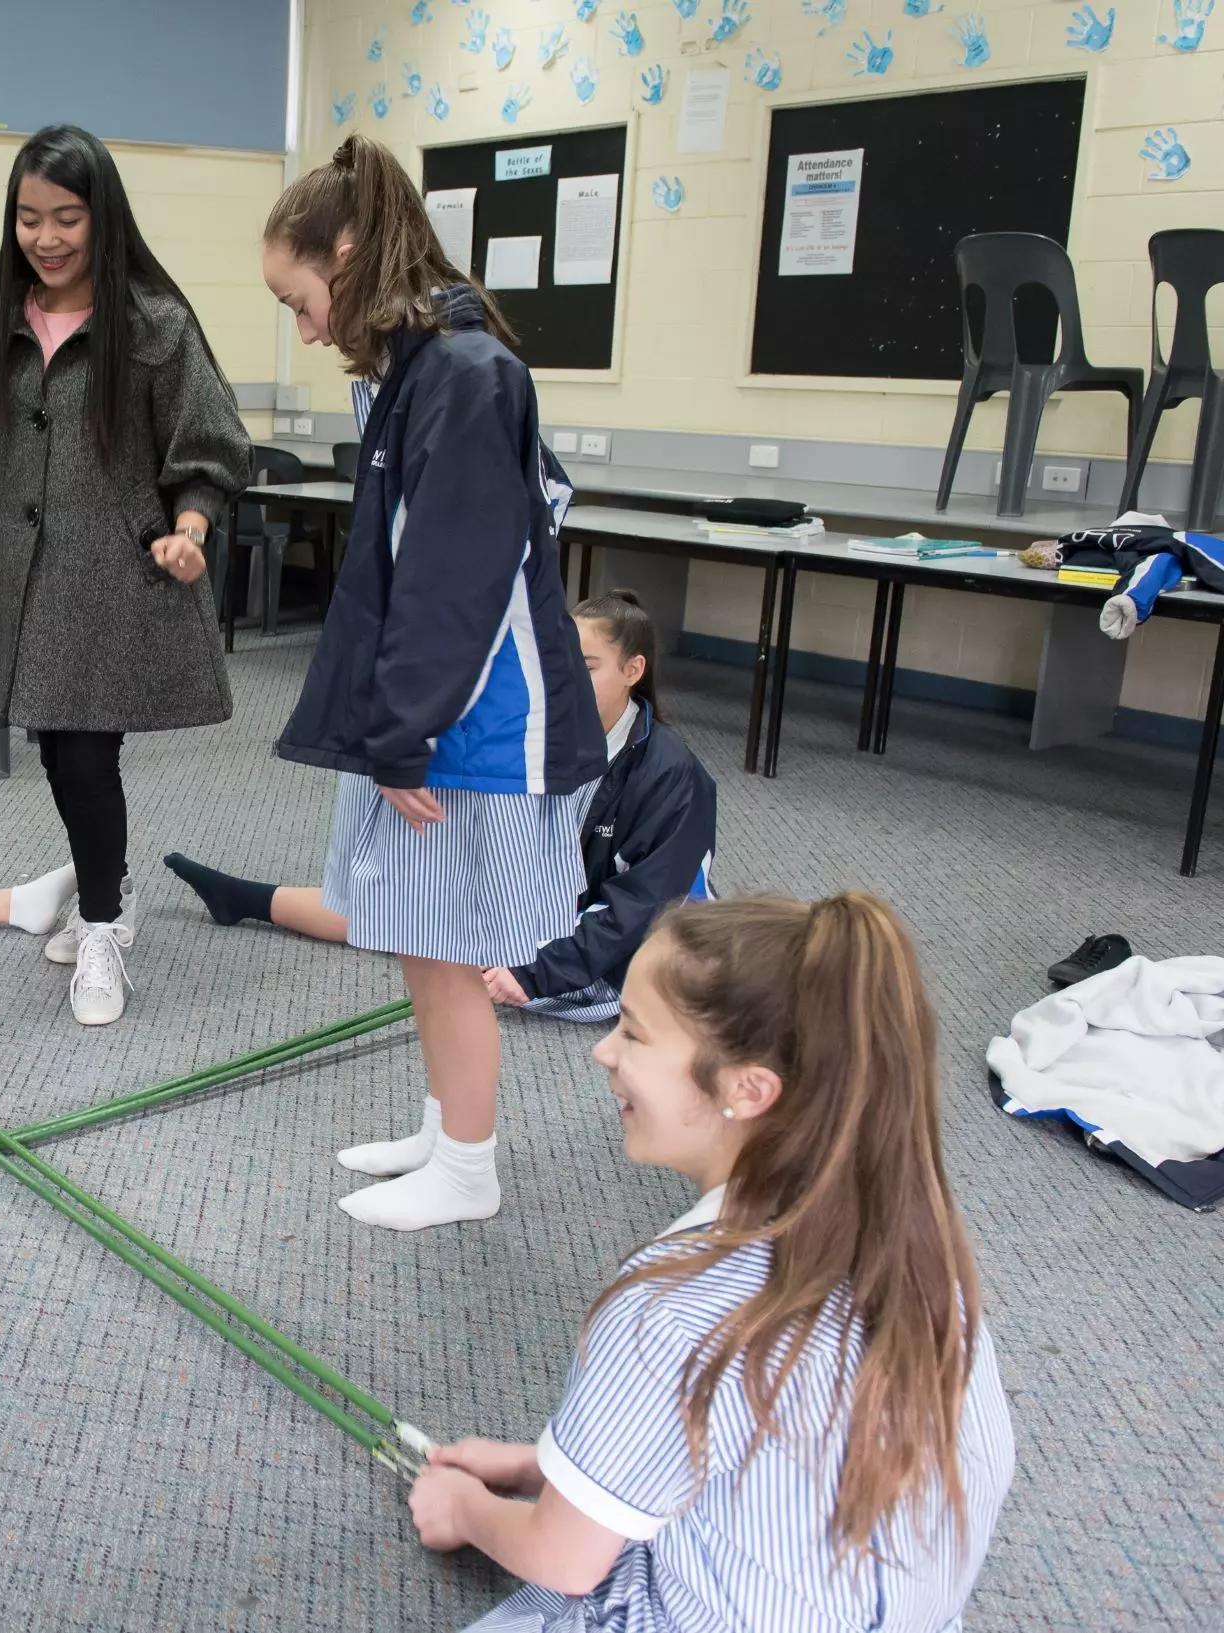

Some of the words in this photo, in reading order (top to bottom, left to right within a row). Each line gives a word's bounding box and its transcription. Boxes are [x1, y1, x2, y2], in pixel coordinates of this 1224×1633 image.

[507, 156, 530, 167] Battle
[534, 154, 544, 164] of
[797, 158, 853, 171] Attendance
[505, 168, 518, 177] the
[806, 170, 843, 182] matters!
[578, 190, 599, 198] Male
